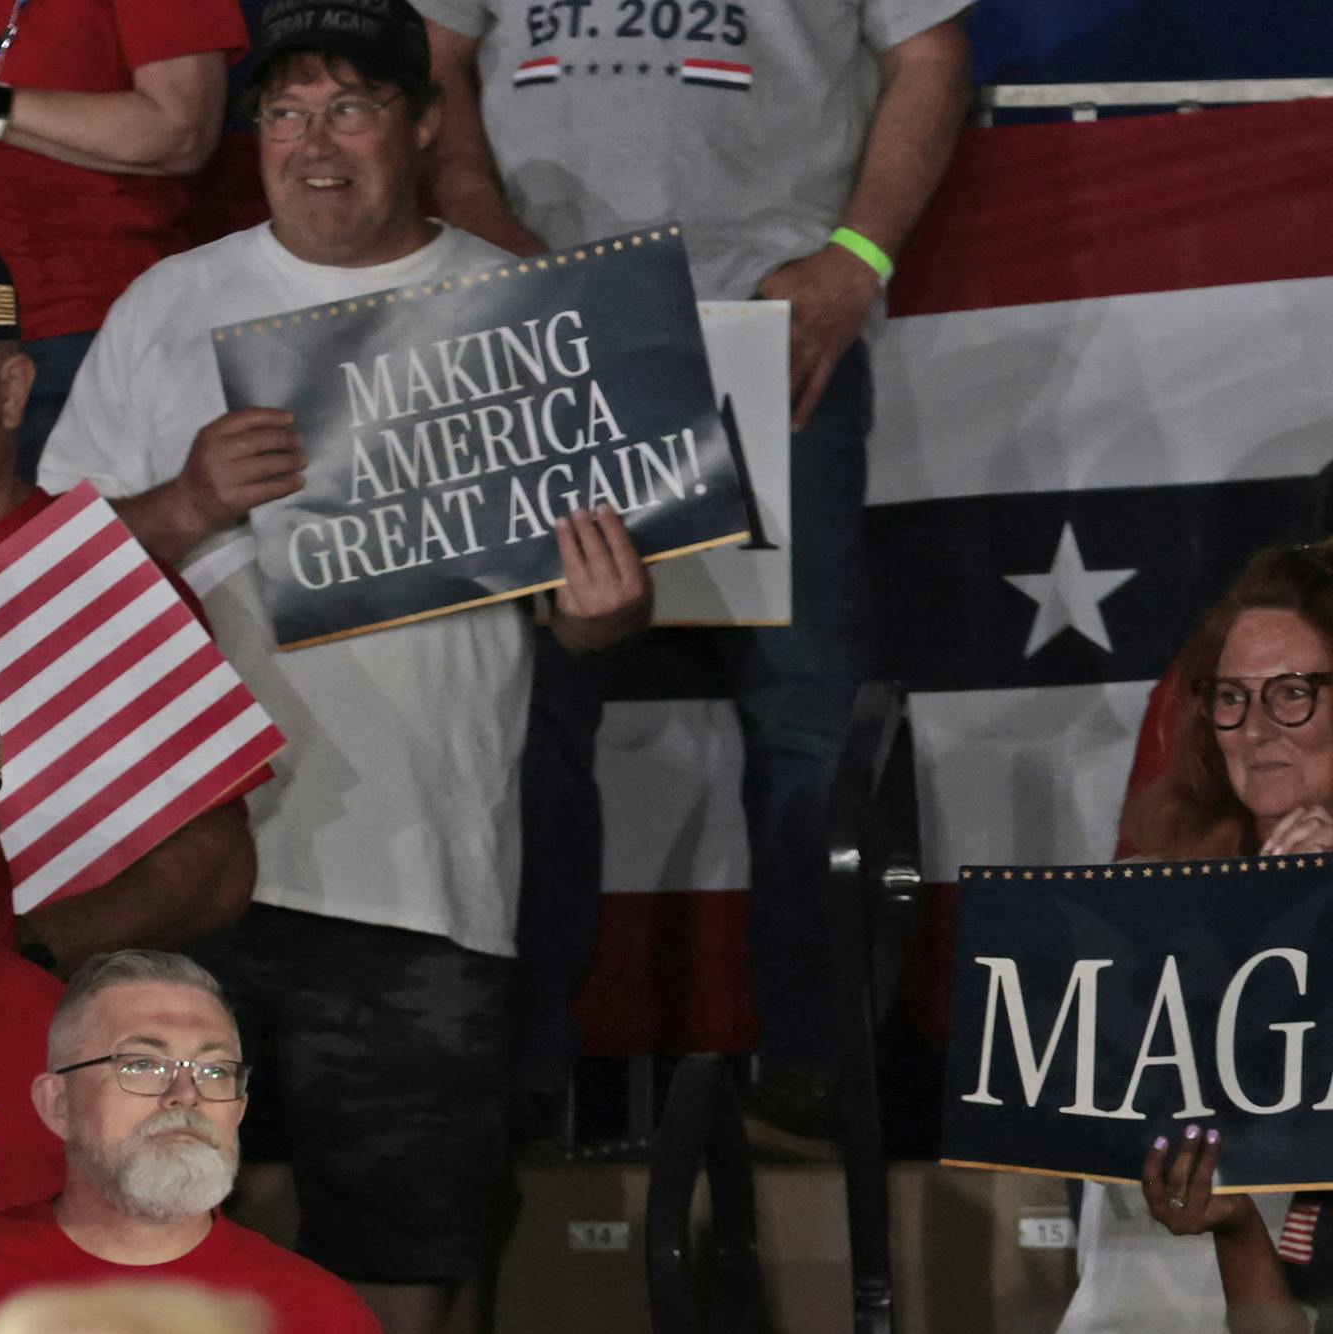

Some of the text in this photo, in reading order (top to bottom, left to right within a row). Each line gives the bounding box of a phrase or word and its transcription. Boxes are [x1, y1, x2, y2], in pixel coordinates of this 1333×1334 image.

[615, 0, 747, 46] 2025
[338, 310, 591, 428] MAKING
[347, 379, 627, 504] AMERICA
[287, 484, 486, 590] GREAT
[504, 428, 708, 545] AGAIN!
[960, 946, 1333, 1120] MAG
[1038, 1224, 1063, 1243] 15
